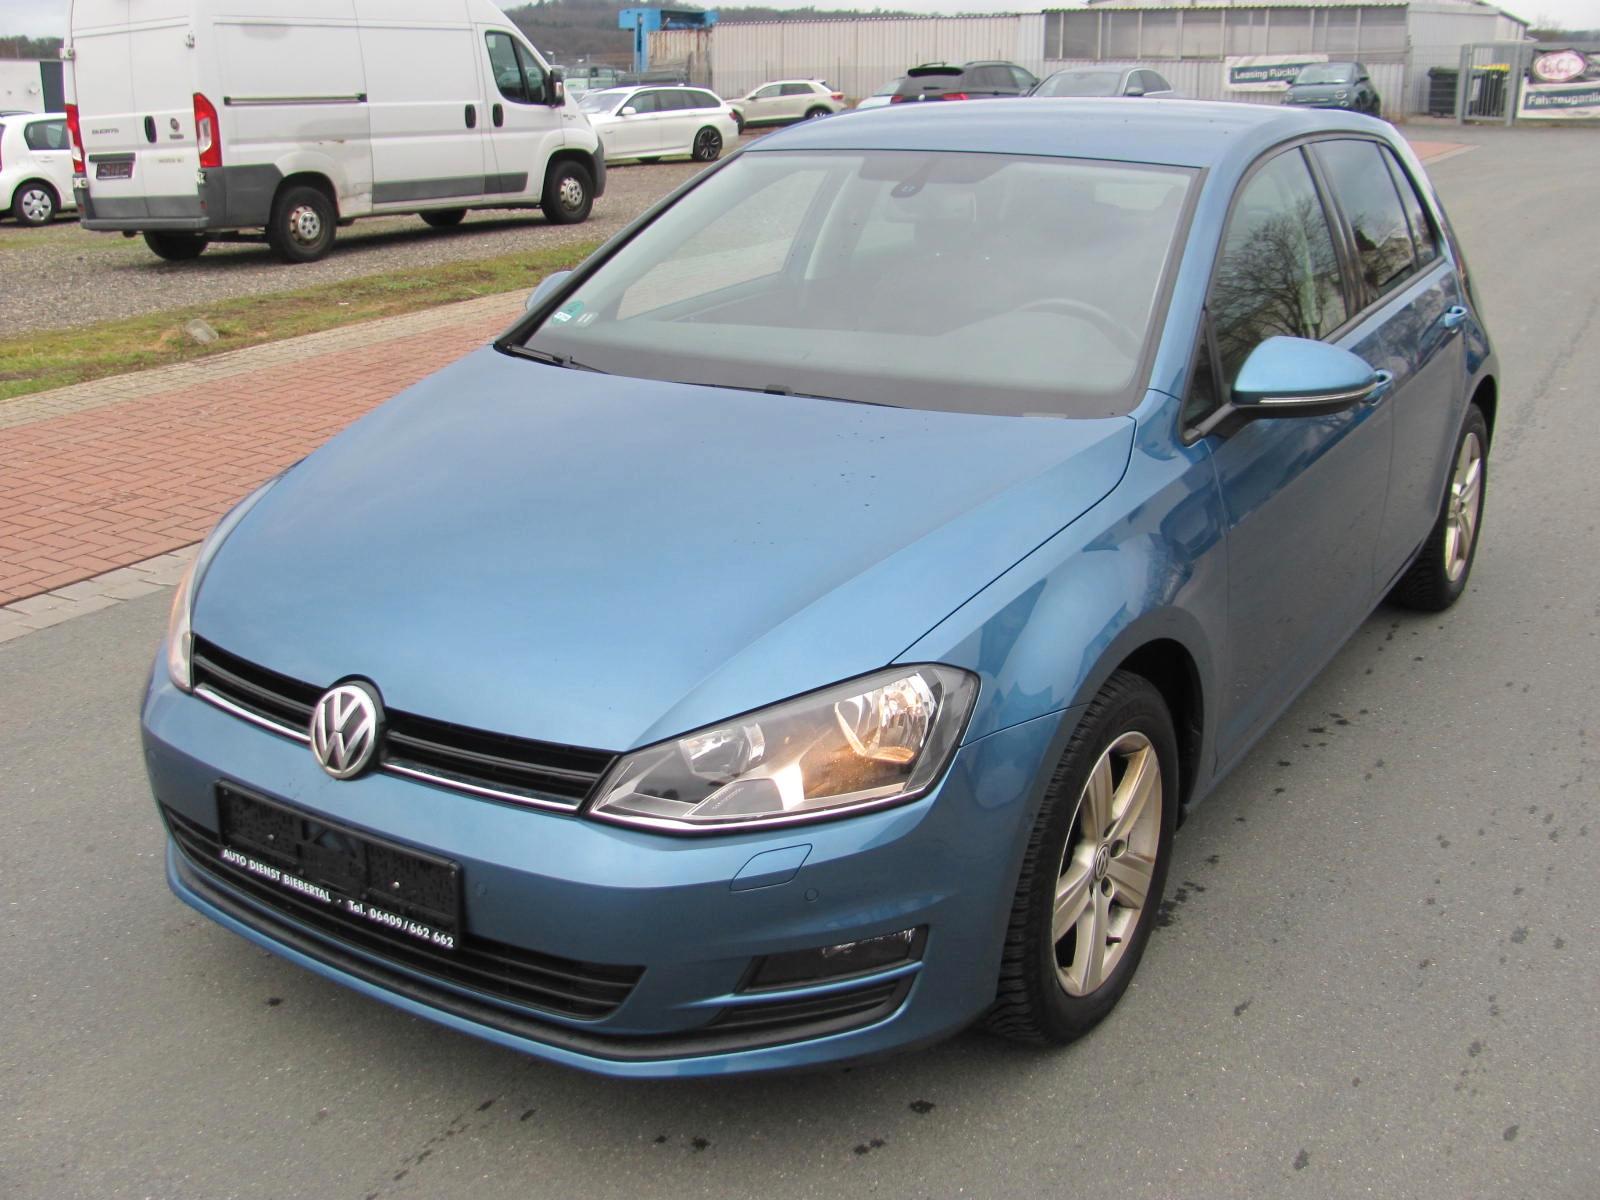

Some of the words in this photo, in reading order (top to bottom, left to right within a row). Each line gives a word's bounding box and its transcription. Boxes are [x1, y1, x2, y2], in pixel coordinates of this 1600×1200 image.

[1234, 69, 1268, 80] Leasing
[222, 848, 247, 867] AUTO
[248, 859, 281, 881] DIENST
[282, 873, 332, 903] BIEBERTAL
[347, 899, 367, 916] Tel.
[432, 931, 454, 949] 662
